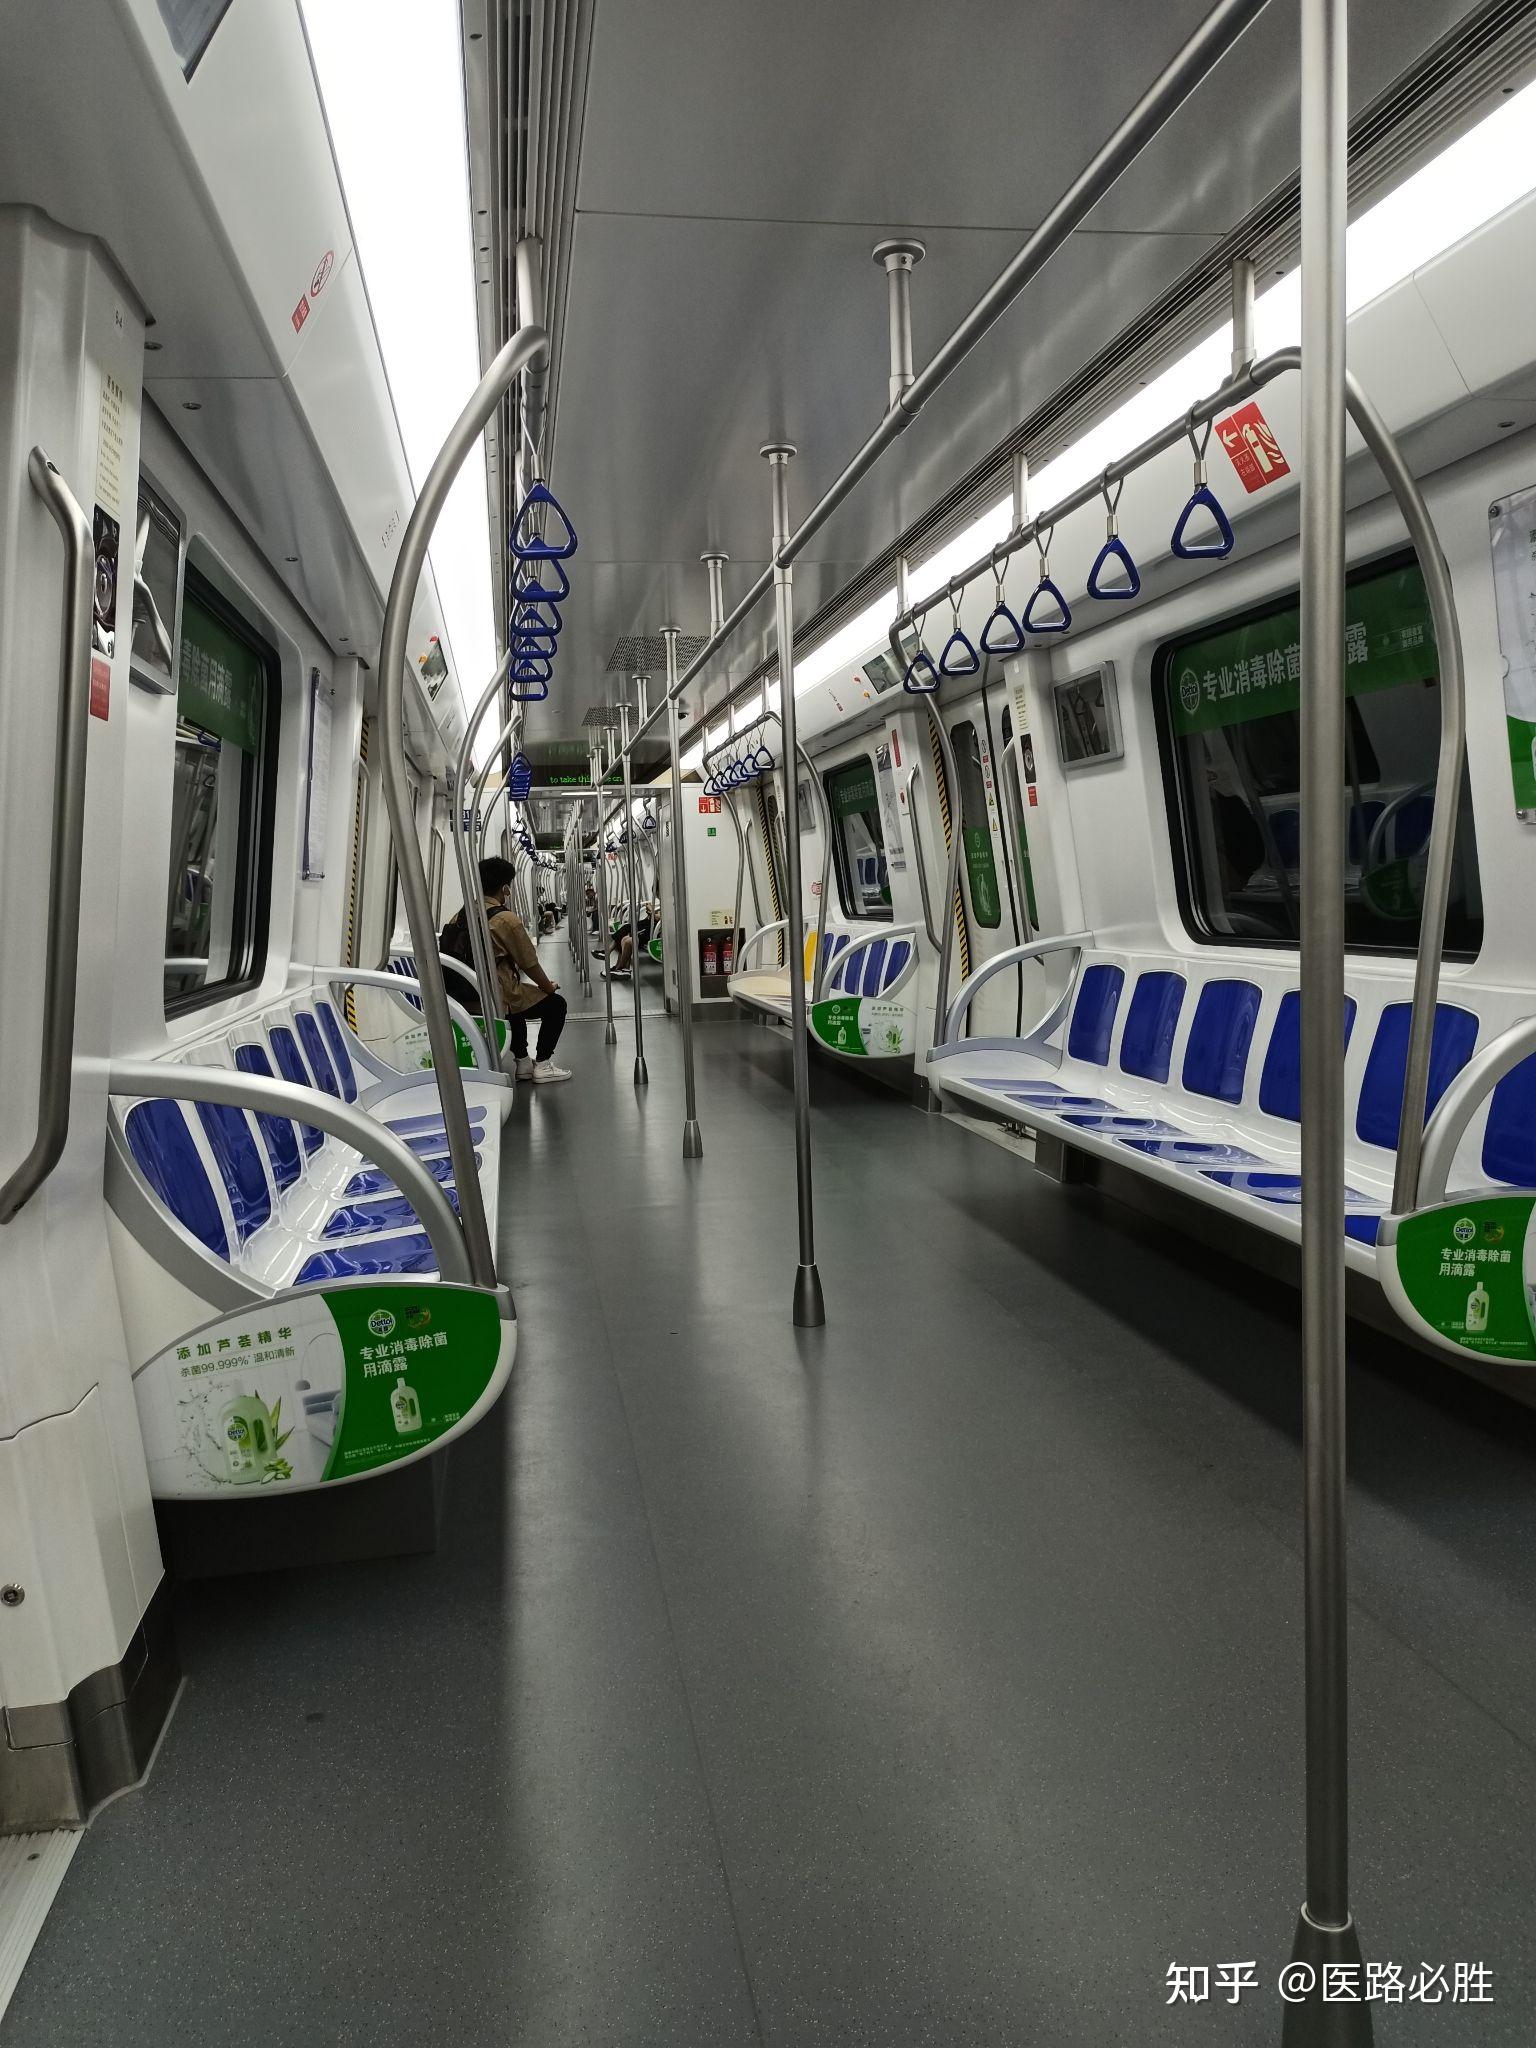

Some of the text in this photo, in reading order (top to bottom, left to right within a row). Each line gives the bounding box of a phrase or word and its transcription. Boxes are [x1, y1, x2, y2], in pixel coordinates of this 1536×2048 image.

[560, 775, 577, 783] take
[578, 774, 592, 783] thi
[1441, 1247, 1512, 1263] 专业消毒除菌
[1439, 1262, 1476, 1277] 用滴露
[370, 1317, 394, 1328] Dettol
[176, 1326, 292, 1360] 添加芦荟精华
[360, 1331, 448, 1360] 专业消毒除菌
[363, 1356, 408, 1378] 用滴露
